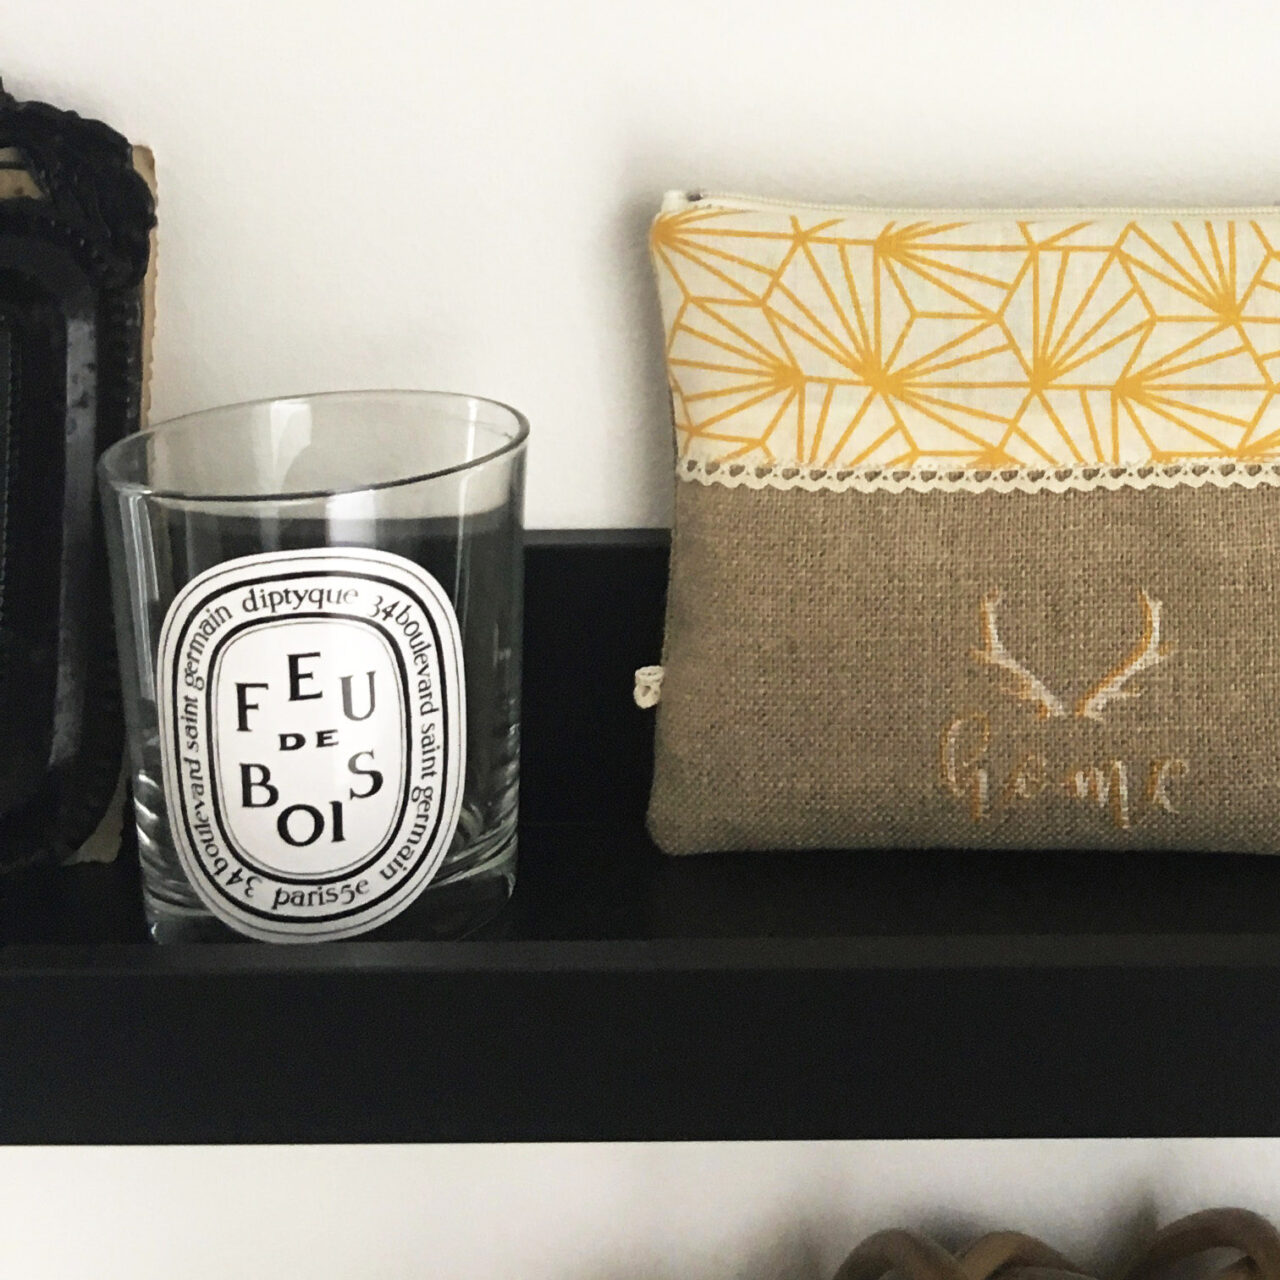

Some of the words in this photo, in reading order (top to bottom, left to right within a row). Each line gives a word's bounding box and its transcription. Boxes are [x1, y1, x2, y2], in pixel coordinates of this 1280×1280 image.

[241, 587, 359, 613] diptyque
[184, 604, 233, 692] germain
[180, 694, 200, 752] saint
[235, 651, 377, 732] FEU
[278, 729, 339, 752] DE
[419, 722, 441, 780] saint
[239, 749, 385, 848] BOIS
[379, 785, 434, 880] germain
